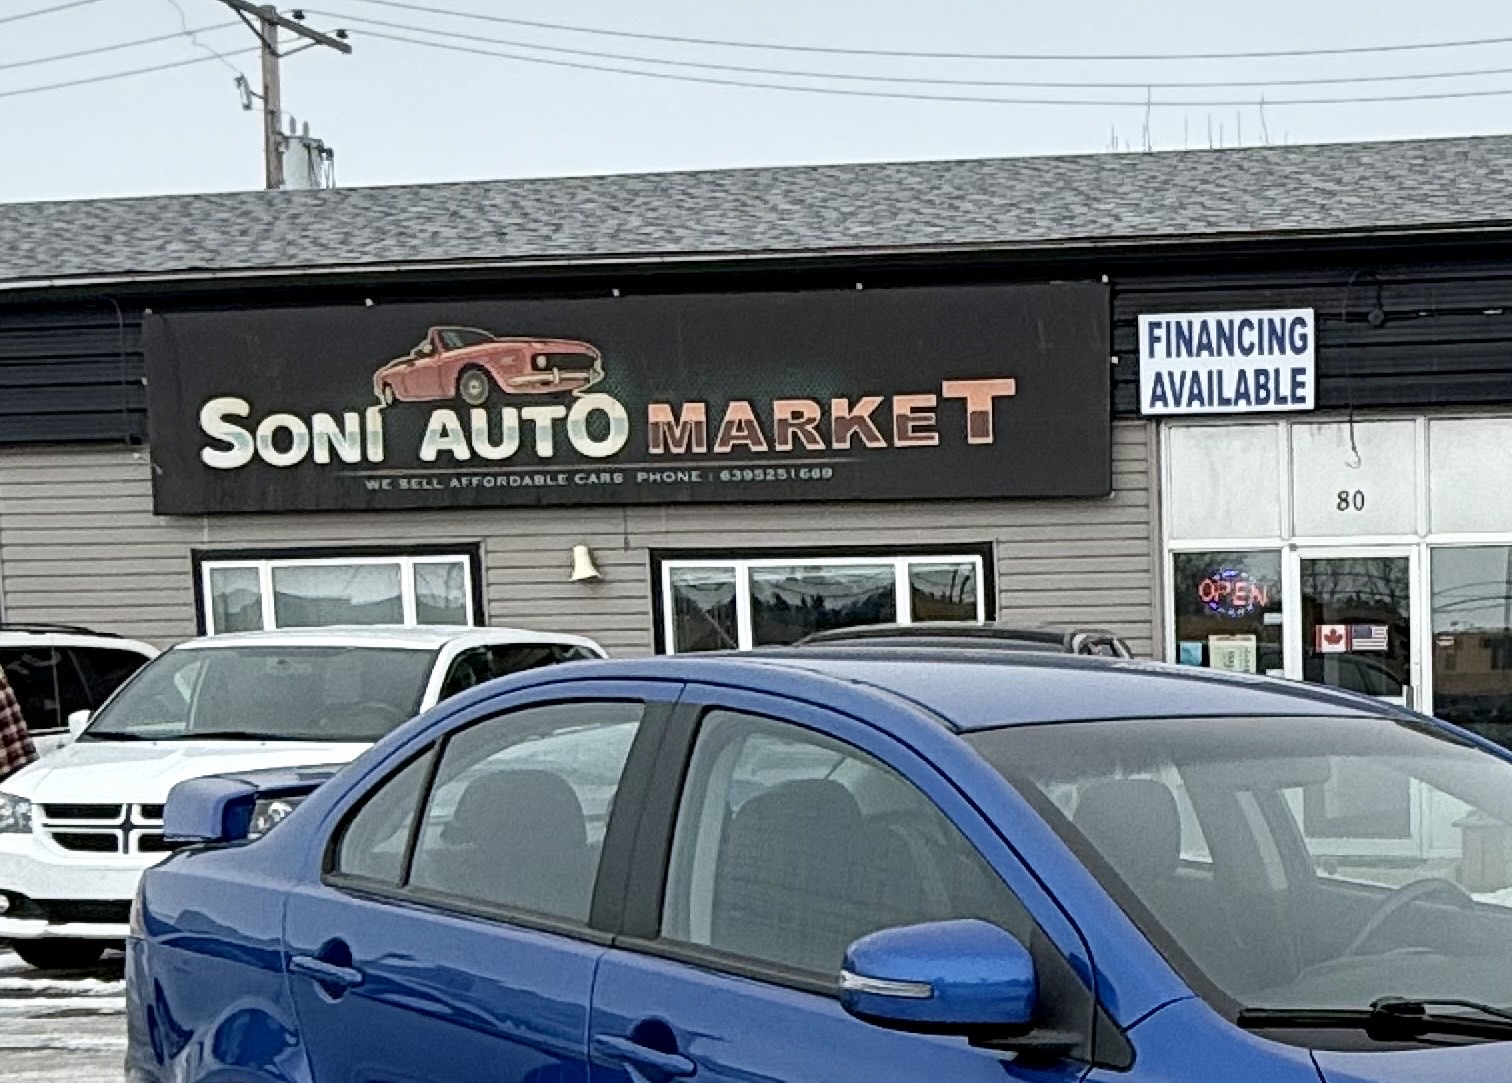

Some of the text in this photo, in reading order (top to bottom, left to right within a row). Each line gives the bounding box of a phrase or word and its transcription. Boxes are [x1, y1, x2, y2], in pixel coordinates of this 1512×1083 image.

[1147, 316, 1309, 359] FINANCING
[1149, 367, 1307, 408] AVAILABLE
[200, 378, 1016, 469] SONI AUTO MARKET
[365, 478, 393, 490] WE
[399, 478, 445, 490] SELL
[449, 473, 569, 489] AFFORDABLE
[574, 471, 625, 485] CARS
[1336, 489, 1366, 512] 80
[1198, 578, 1269, 607] OPEN
